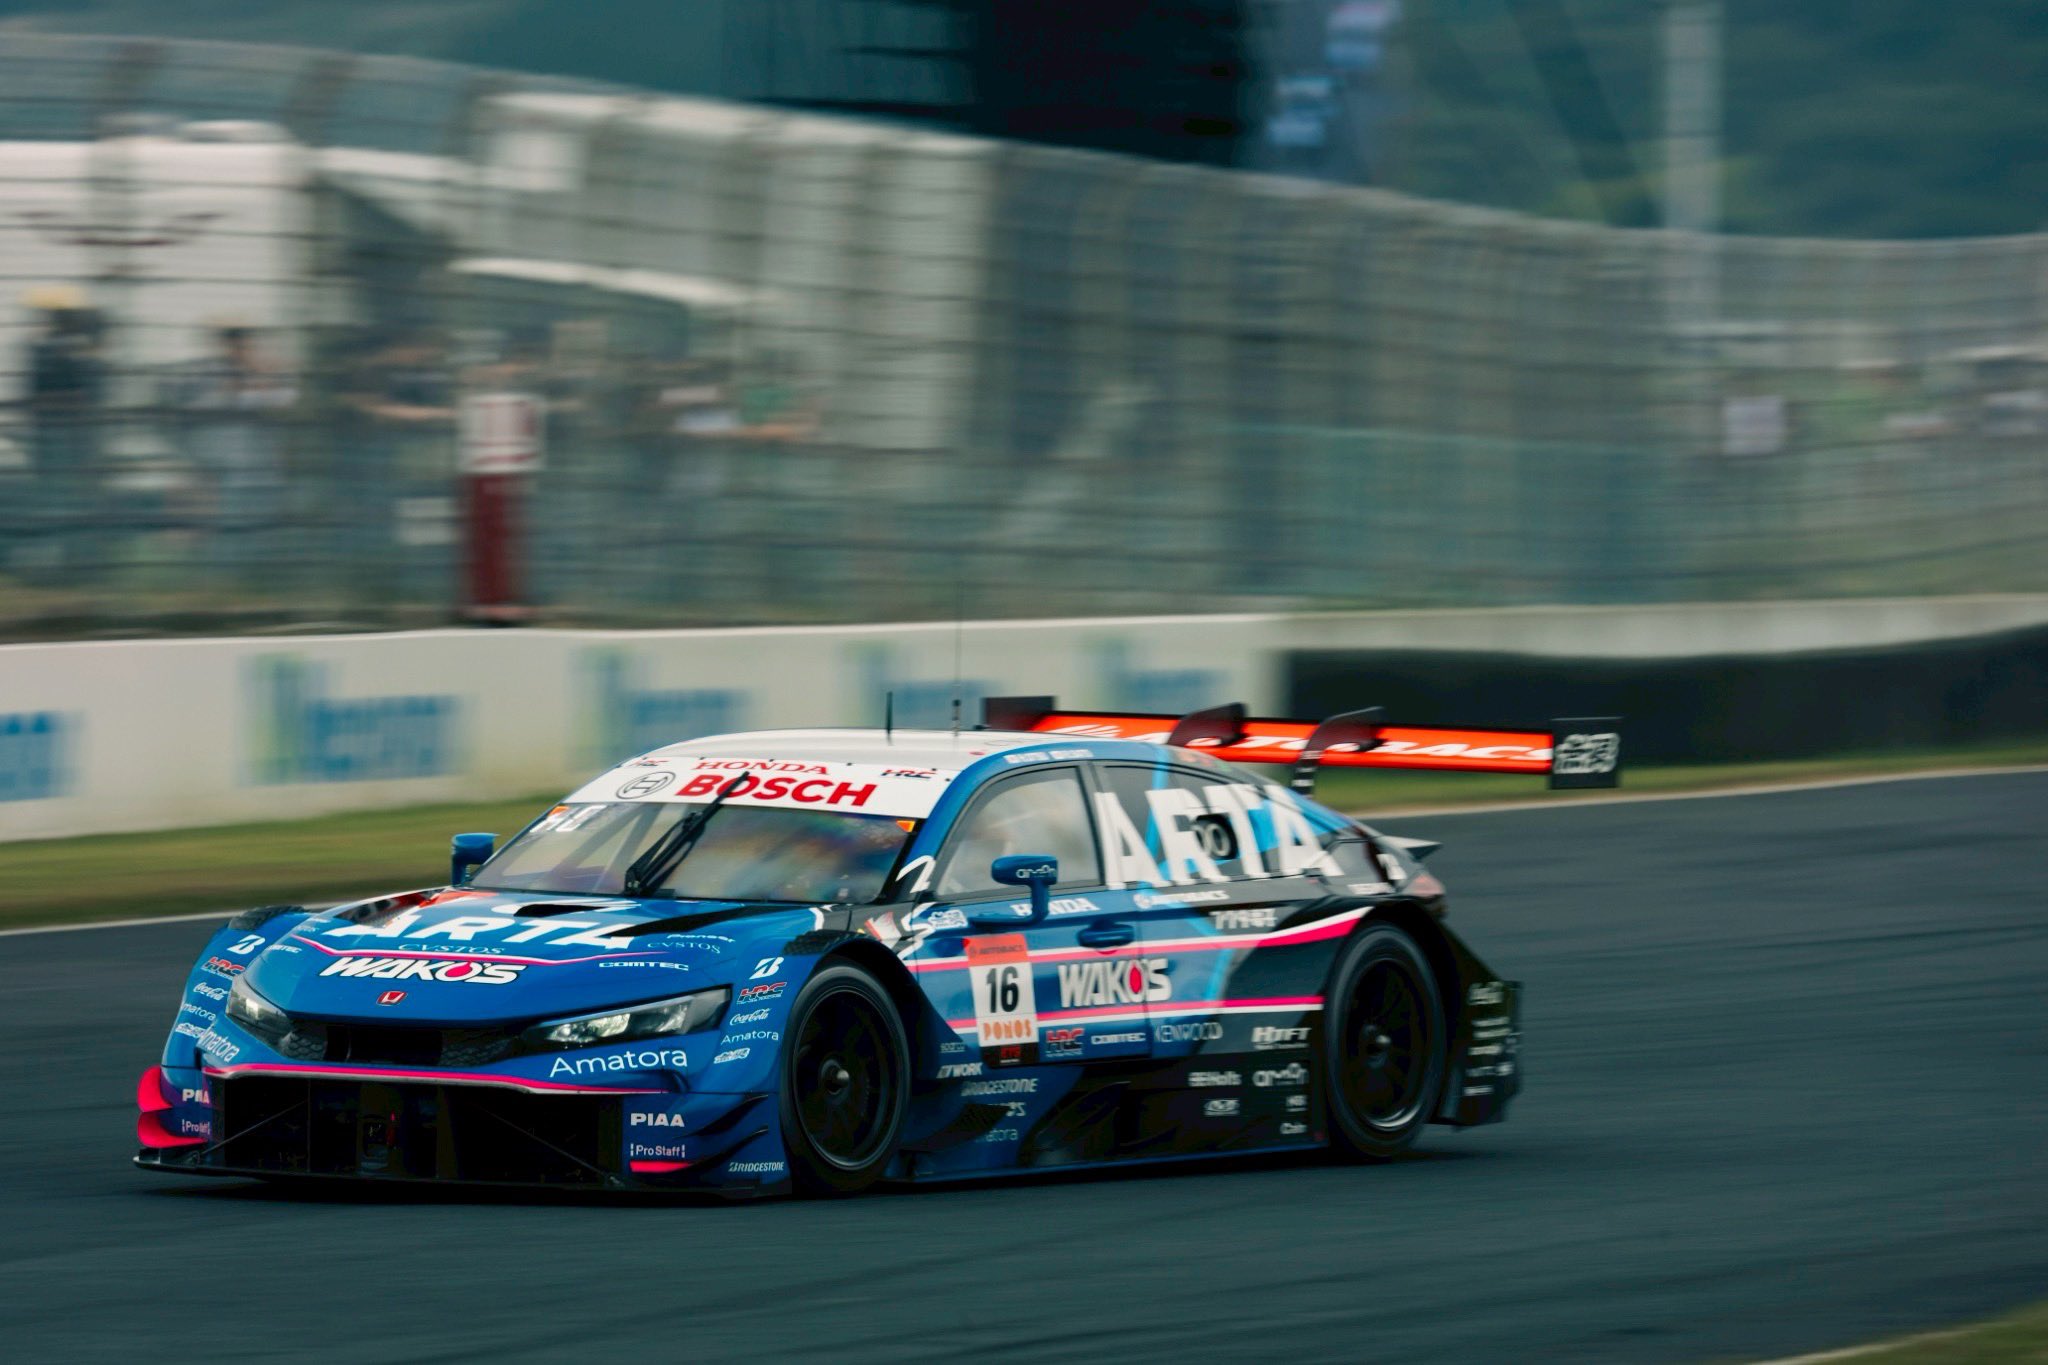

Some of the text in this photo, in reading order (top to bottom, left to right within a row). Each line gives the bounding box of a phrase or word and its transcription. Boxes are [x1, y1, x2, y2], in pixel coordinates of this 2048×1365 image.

[692, 760, 829, 775] HONDA
[880, 769, 936, 779] HRC
[675, 774, 878, 807] BOSCH
[1094, 784, 1345, 890] ARTA
[1011, 898, 1099, 917] HNDA
[319, 956, 528, 984] WAKO'S
[599, 961, 690, 971] COMTEC
[738, 981, 787, 1002] HRC
[986, 966, 1019, 1014] 16
[181, 1002, 217, 1021] matora
[721, 1030, 780, 1045] Amatora
[983, 1019, 1032, 1040] PONOS
[549, 1049, 688, 1078] Amatora
[630, 1113, 685, 1128] PIAA
[728, 1161, 785, 1173] BRIDGESTONE
